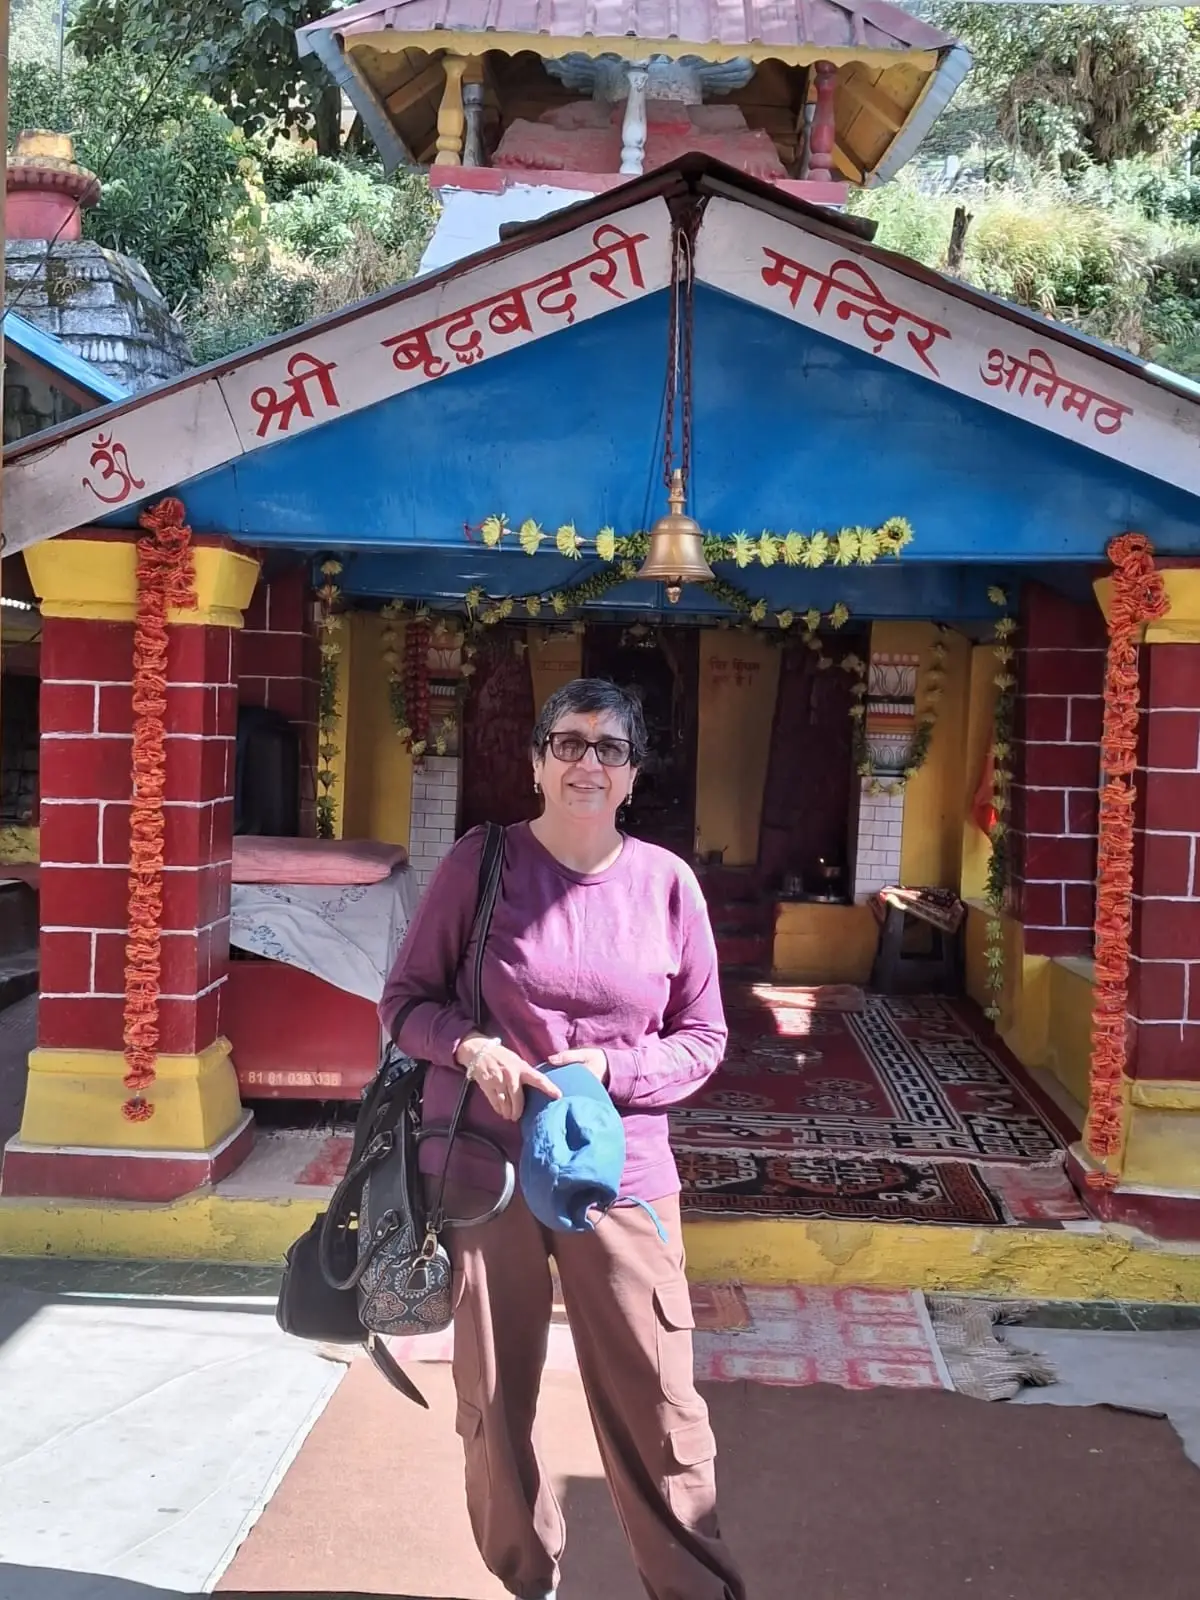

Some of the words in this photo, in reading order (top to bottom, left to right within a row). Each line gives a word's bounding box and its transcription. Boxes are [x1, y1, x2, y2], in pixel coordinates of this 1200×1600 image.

[761, 246, 951, 378] मन्दिर
[979, 347, 1134, 435] अनिमठ
[251, 352, 338, 437] श्री
[248, 1071, 263, 1085] 81
